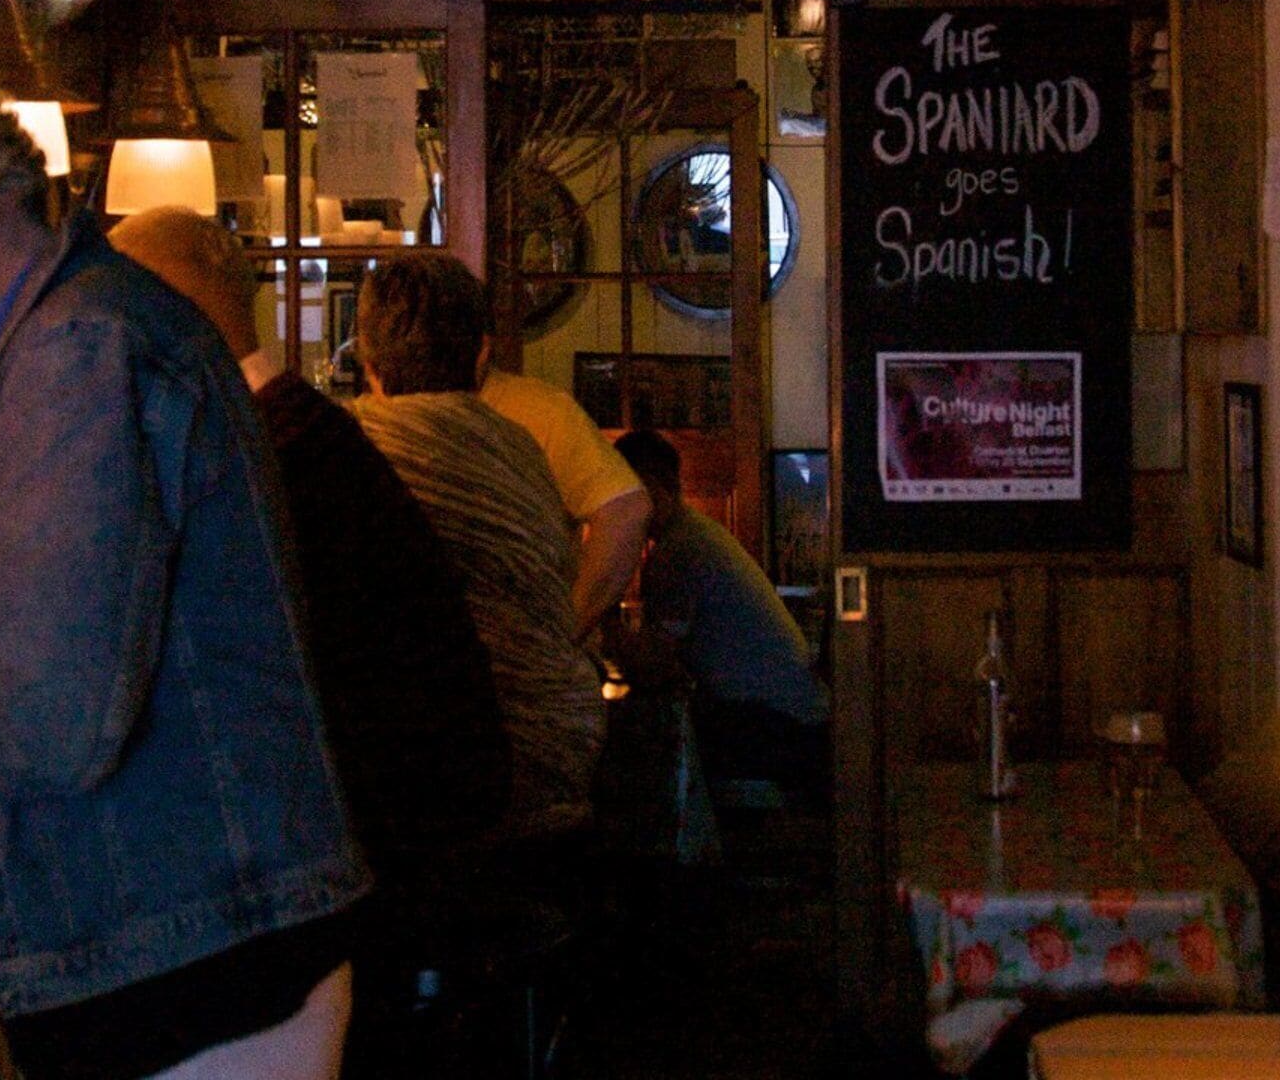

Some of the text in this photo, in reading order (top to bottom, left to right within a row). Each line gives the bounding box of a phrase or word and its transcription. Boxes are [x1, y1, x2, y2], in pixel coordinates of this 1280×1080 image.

[921, 12, 1001, 73] THE
[872, 65, 1101, 165] SPANIARD
[938, 166, 1021, 216] goes
